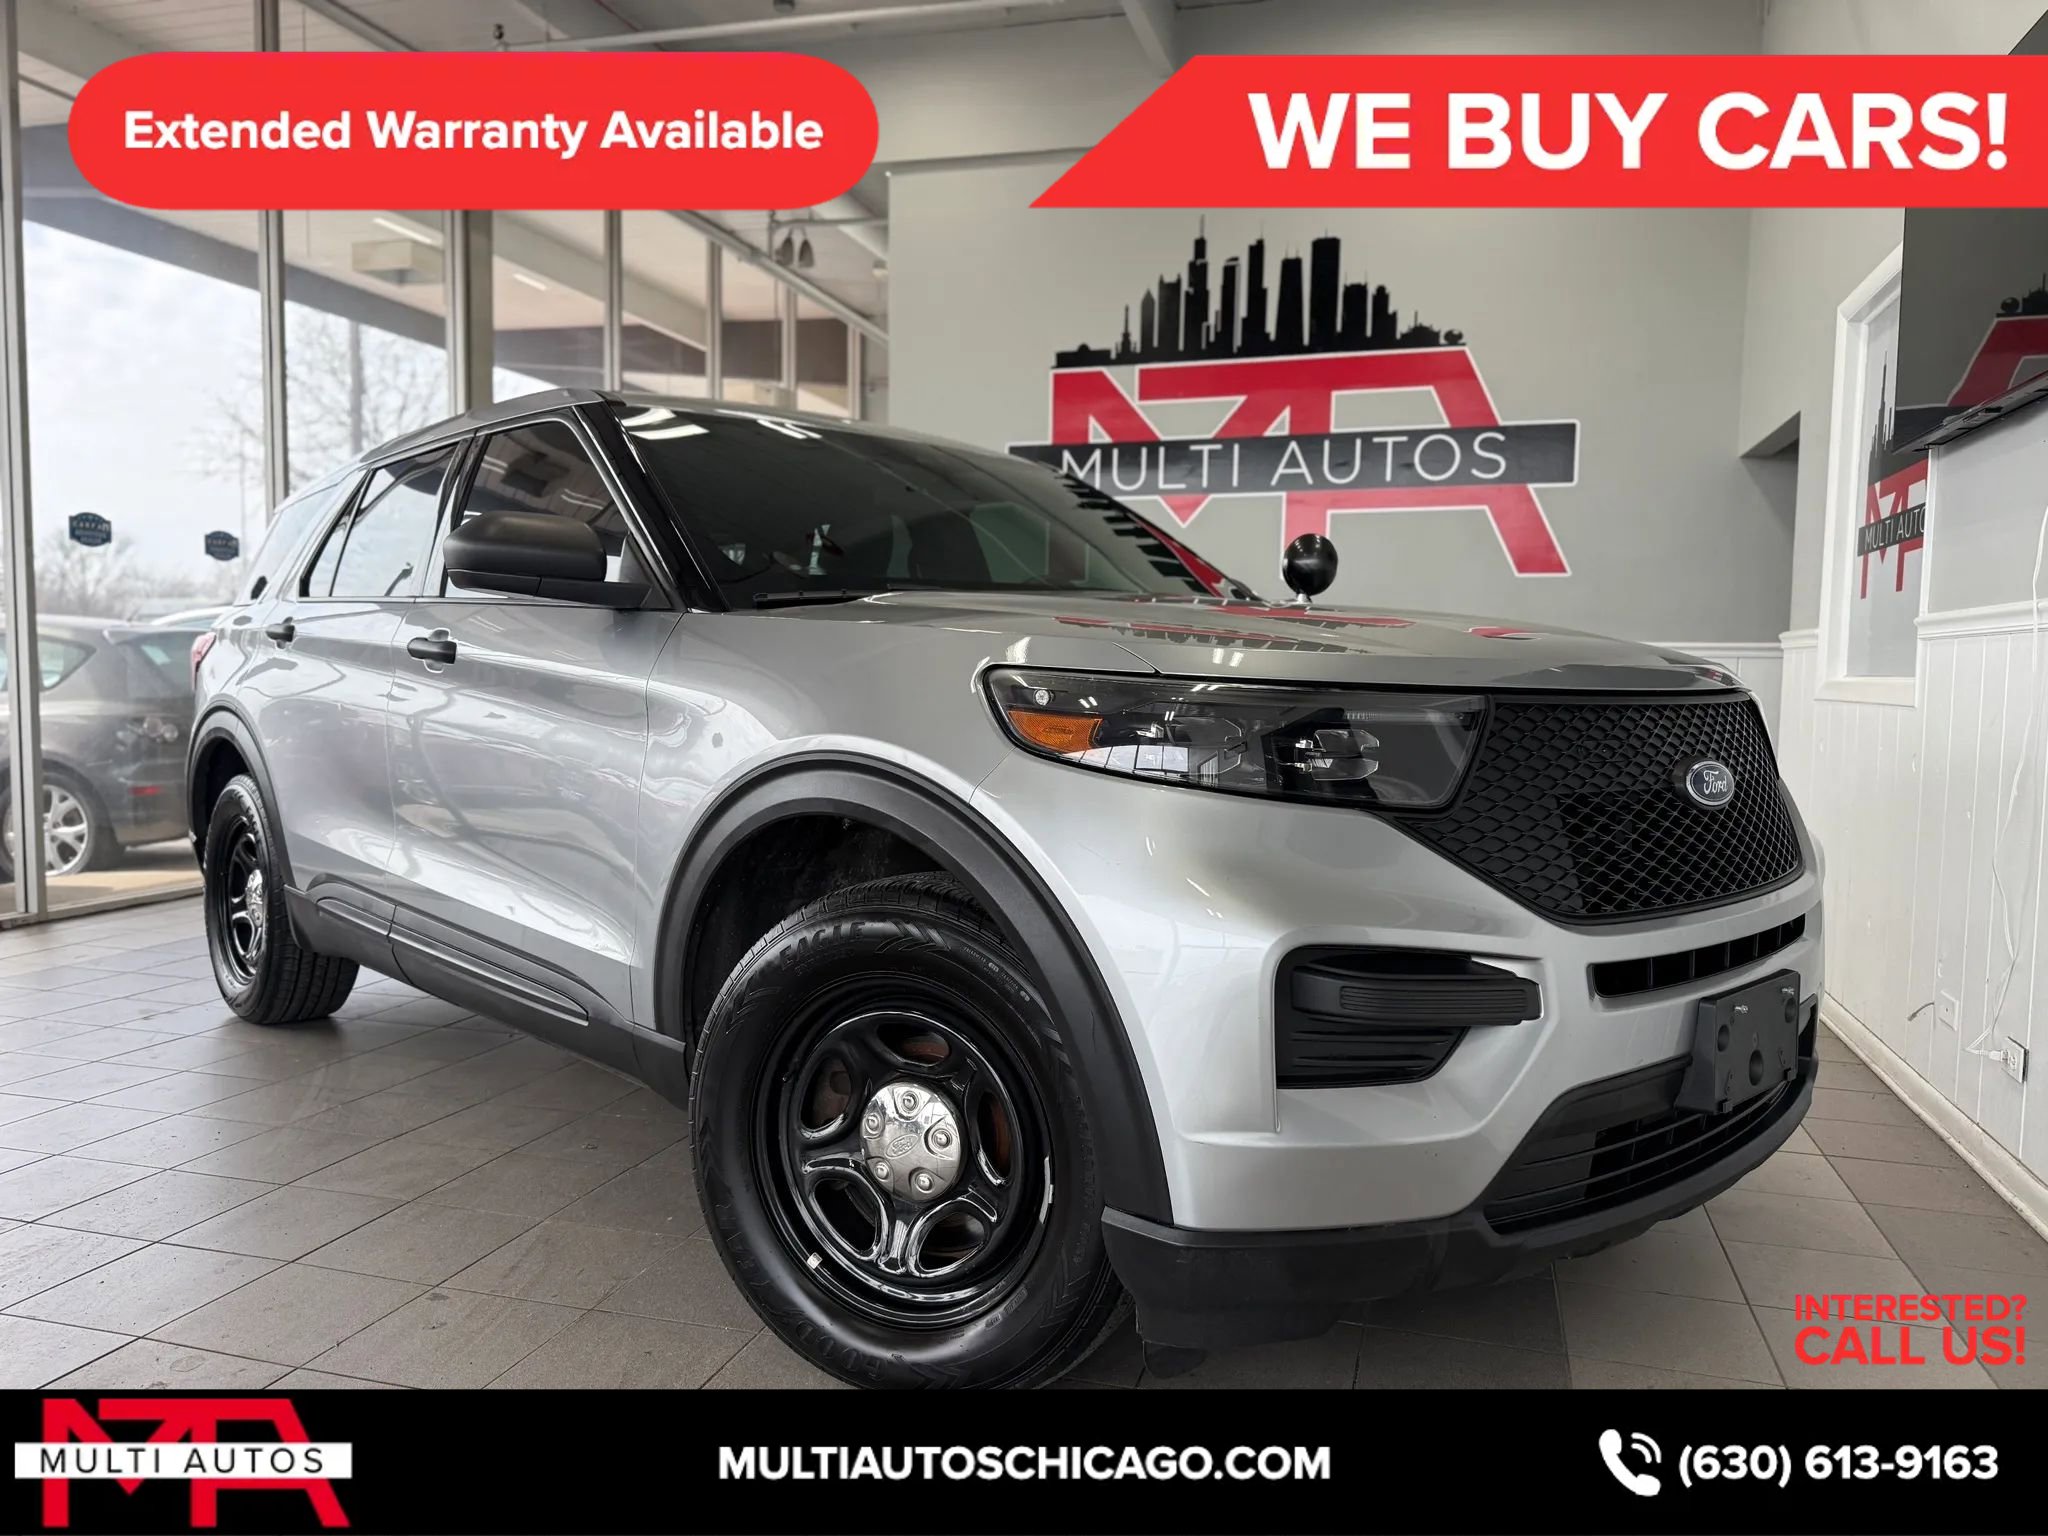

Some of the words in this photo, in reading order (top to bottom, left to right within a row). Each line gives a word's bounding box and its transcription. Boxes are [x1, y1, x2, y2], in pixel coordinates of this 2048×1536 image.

[1060, 443, 1240, 492] MULTI
[1271, 432, 1508, 486] AUTOS
[1865, 518, 1894, 551] MULTI
[1703, 770, 1728, 795] Ford
